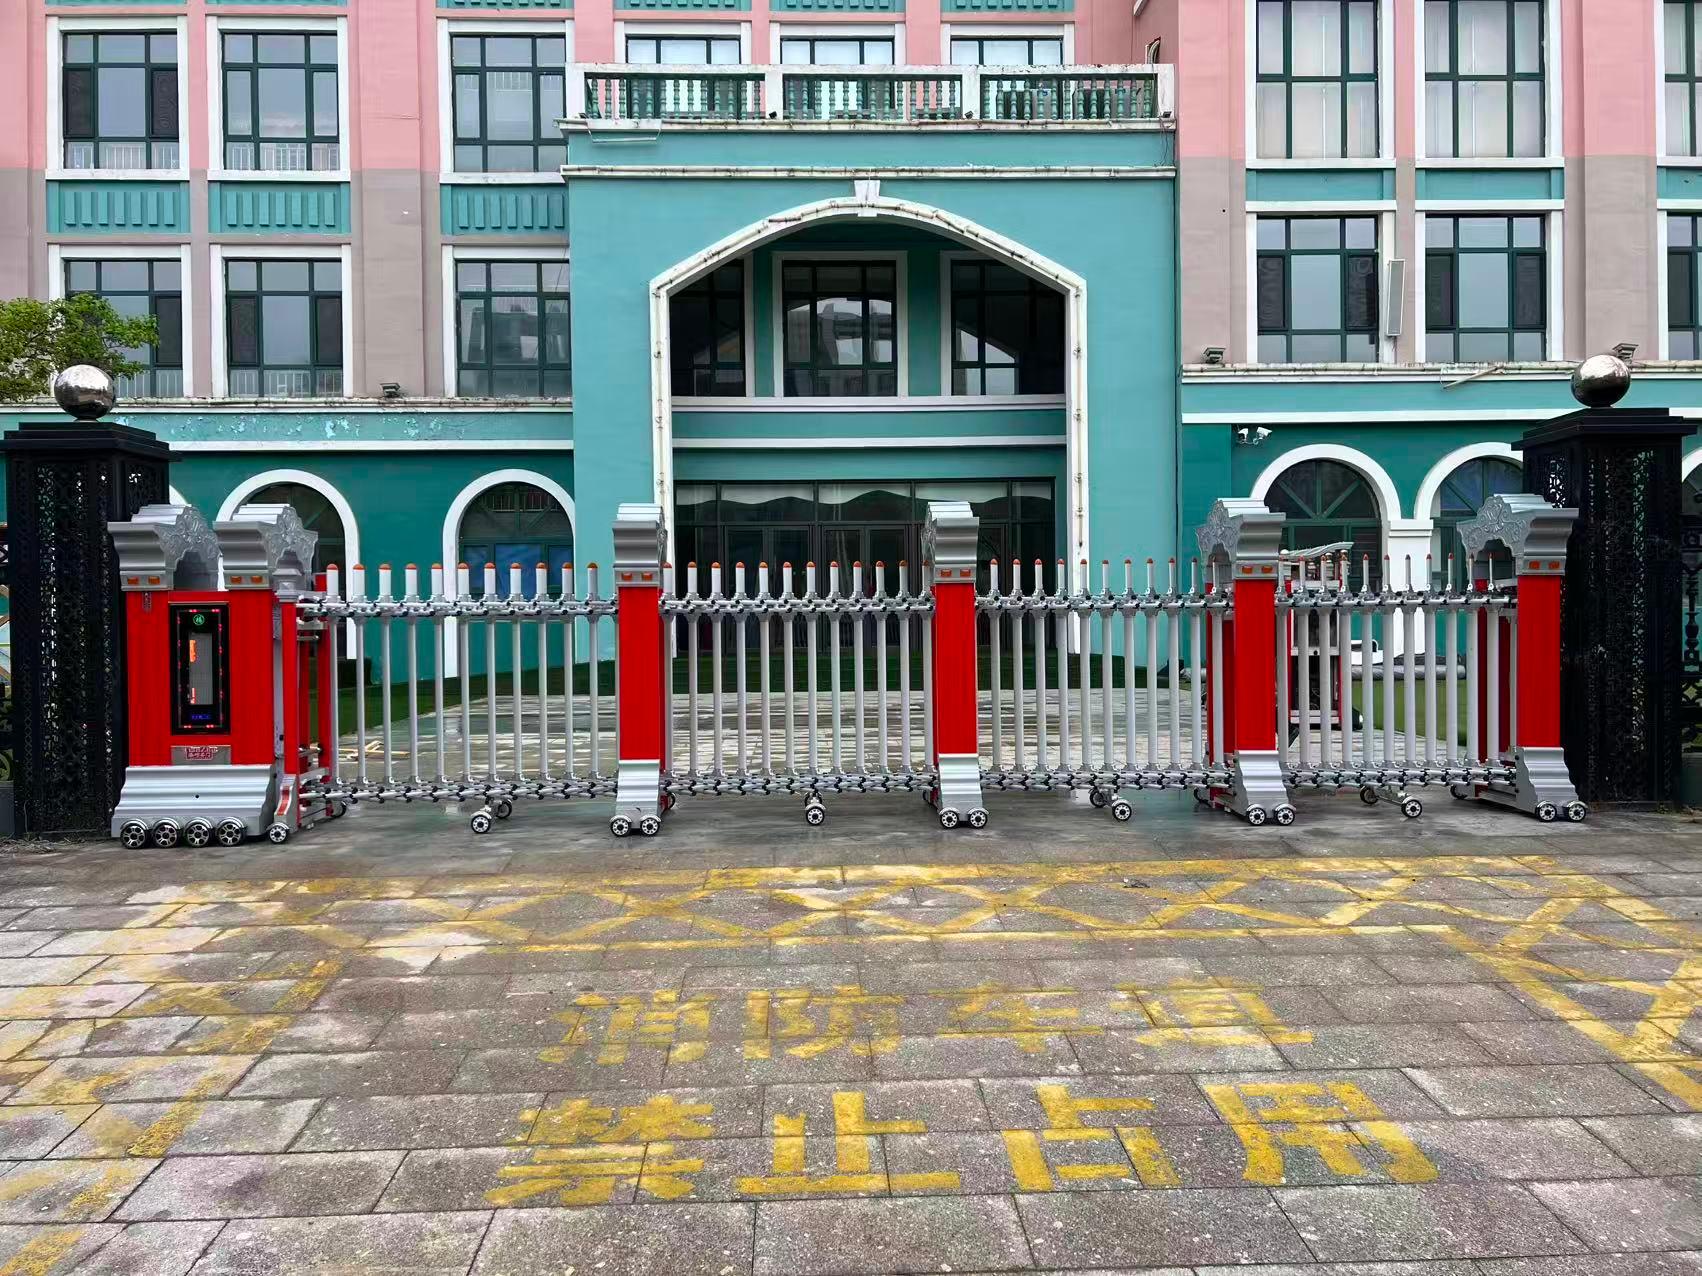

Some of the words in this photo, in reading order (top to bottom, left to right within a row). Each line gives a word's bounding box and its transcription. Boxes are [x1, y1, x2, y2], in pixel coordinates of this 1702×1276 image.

[537, 980, 1314, 1066] 消防车道
[482, 1080, 1440, 1206] 禁止占用
